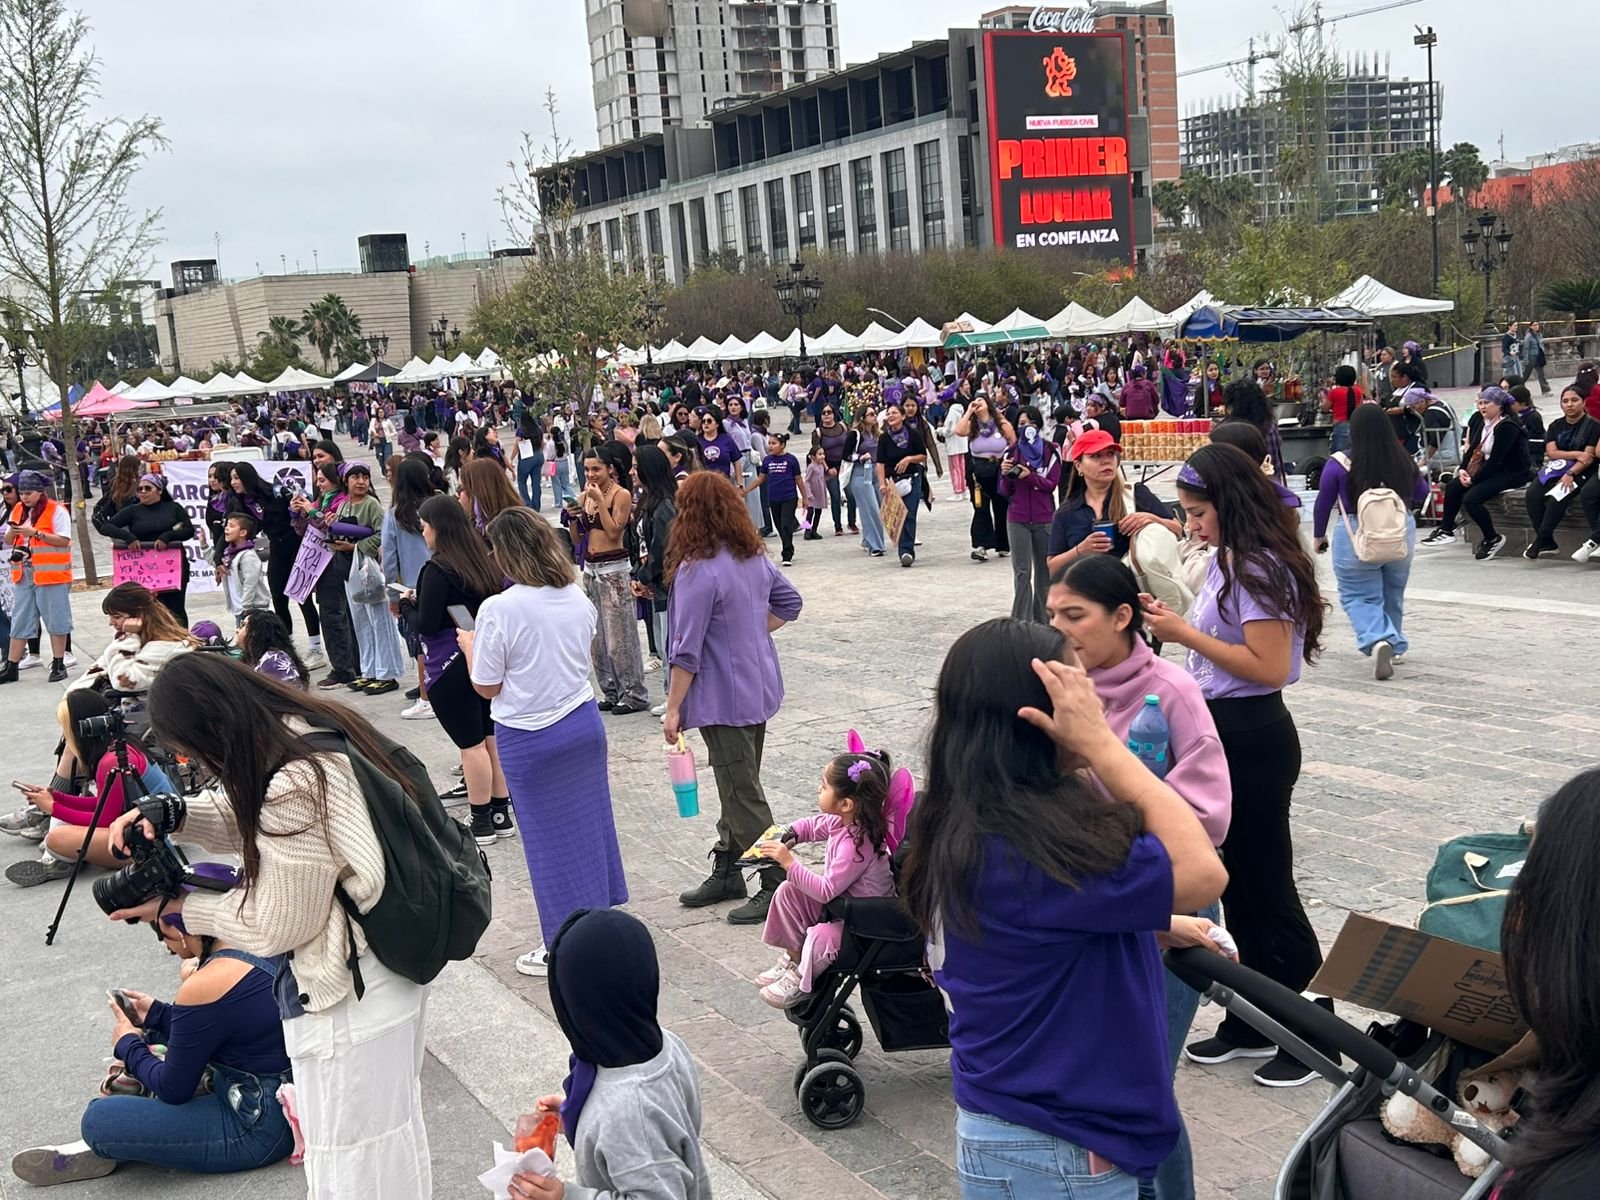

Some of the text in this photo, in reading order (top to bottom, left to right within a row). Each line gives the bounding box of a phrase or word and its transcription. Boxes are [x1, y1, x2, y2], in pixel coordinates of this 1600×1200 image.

[1028, 5, 1097, 33] Coca-Cola
[1028, 118, 1096, 127] NUEVA FUERZA CIVIL
[998, 136, 1128, 179] PRIMER
[1020, 186, 1112, 224] LUGAR
[1016, 228, 1119, 247] EN CONFIANZA
